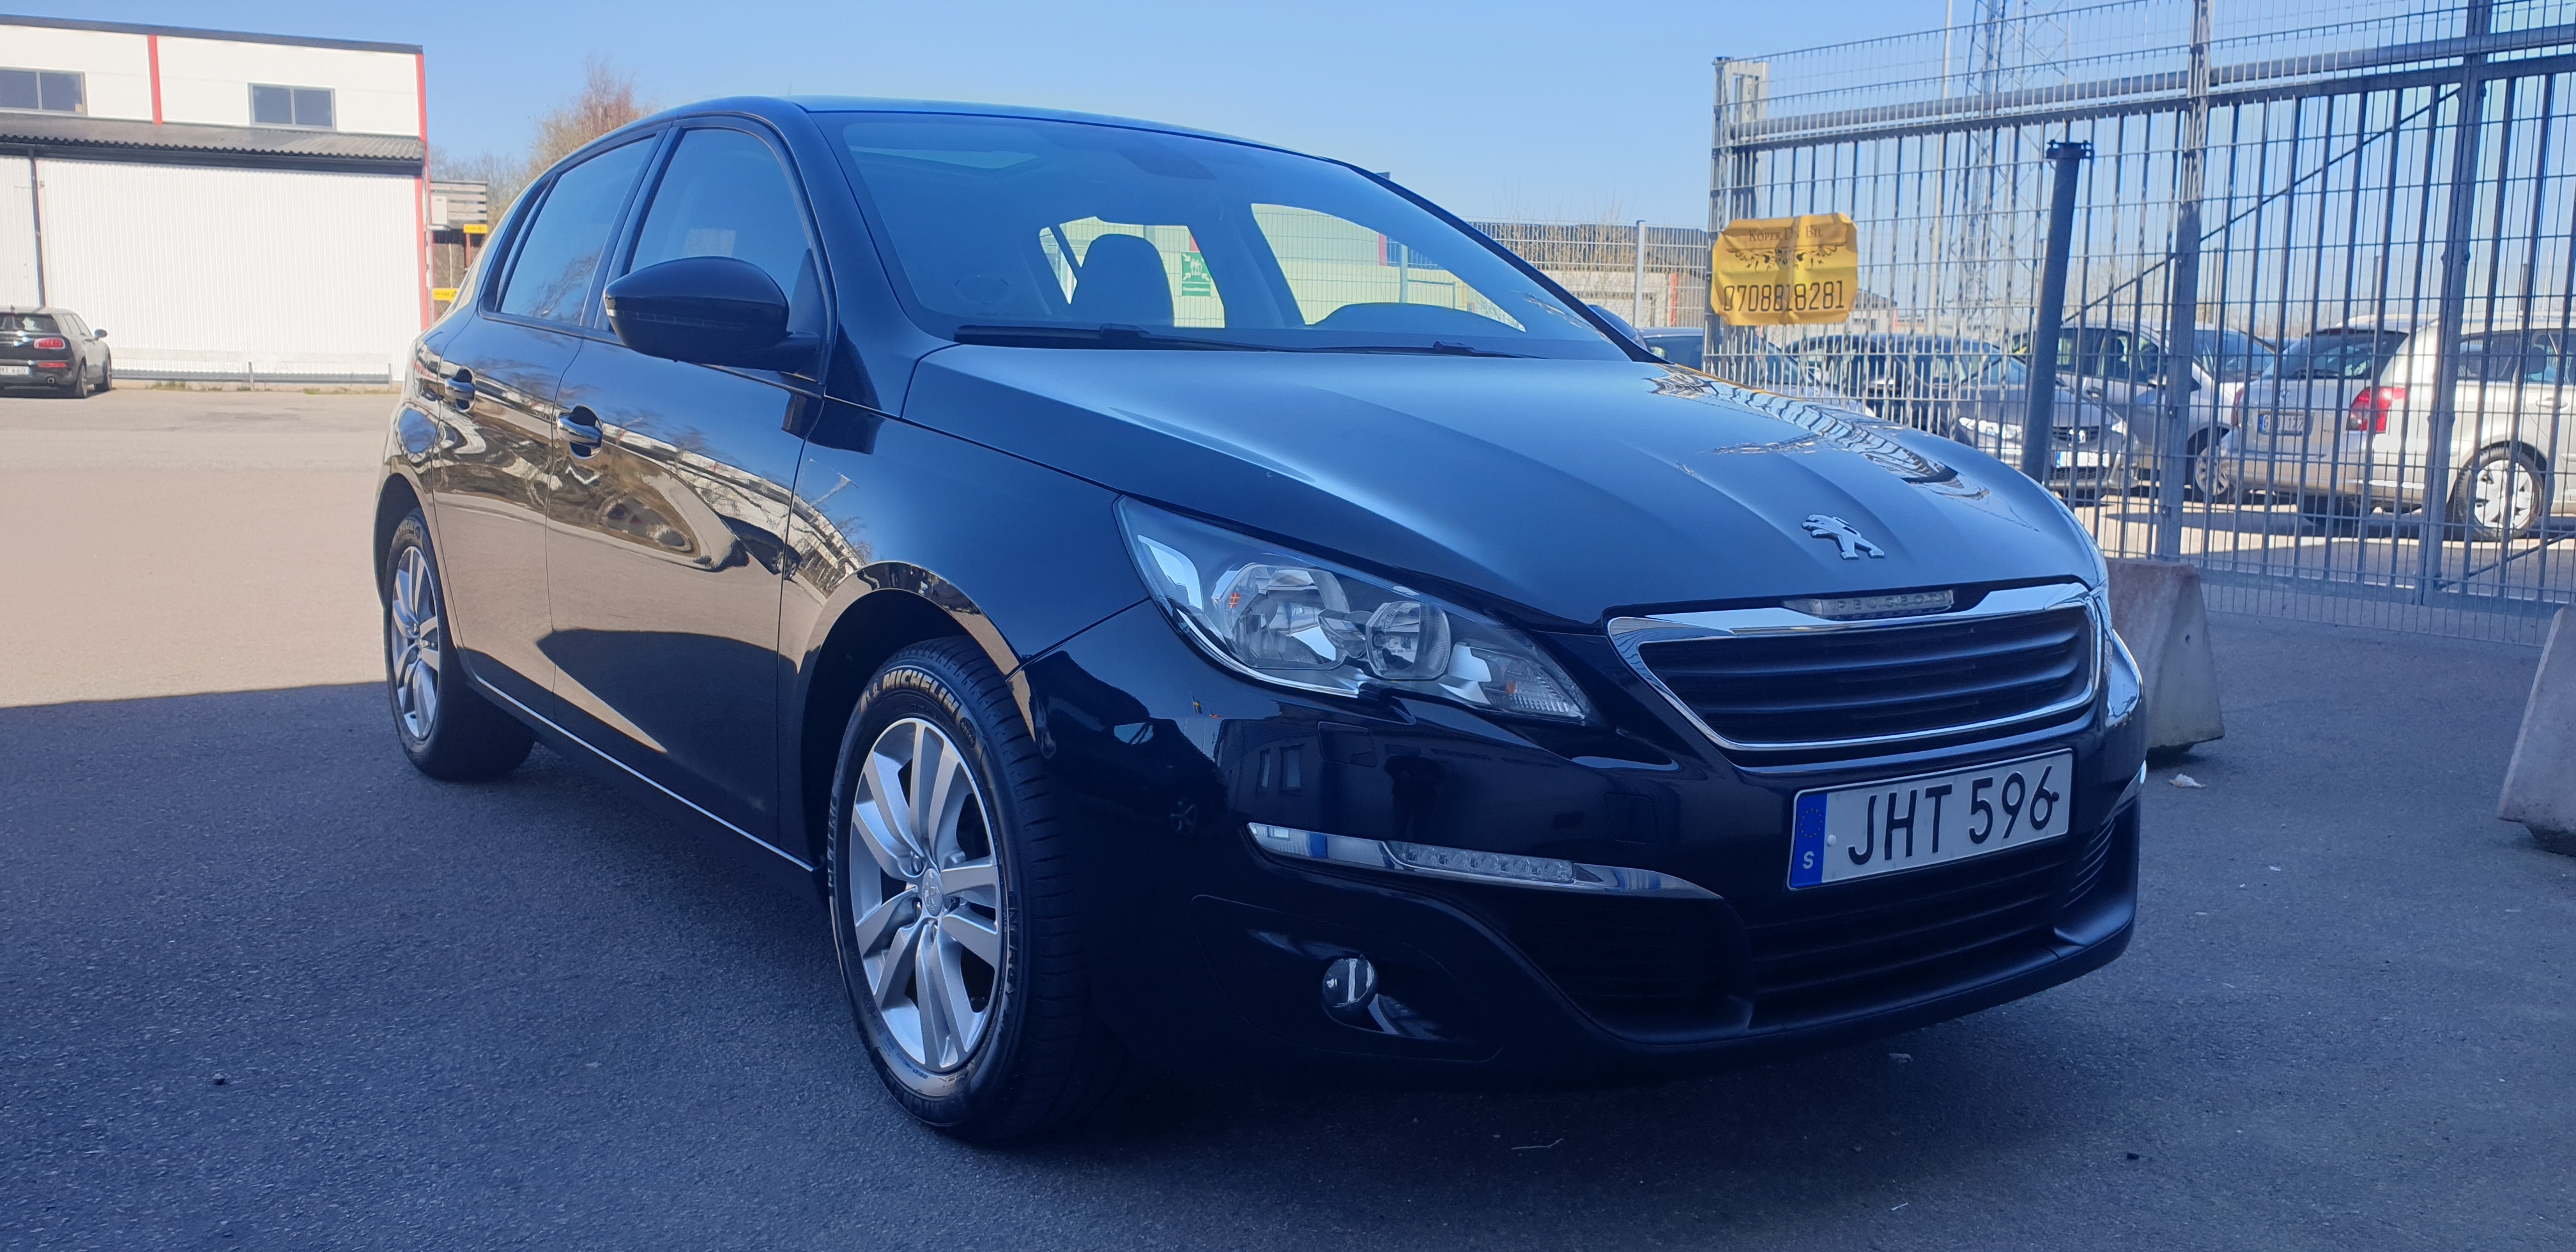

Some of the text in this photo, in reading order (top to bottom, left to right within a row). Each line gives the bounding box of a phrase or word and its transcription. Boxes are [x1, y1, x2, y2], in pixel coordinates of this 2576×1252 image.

[1724, 280, 1844, 312] 0708818281
[882, 669, 961, 719] MICHELIN
[1848, 766, 2056, 865] JHT 596
[1803, 851, 1814, 869] S
